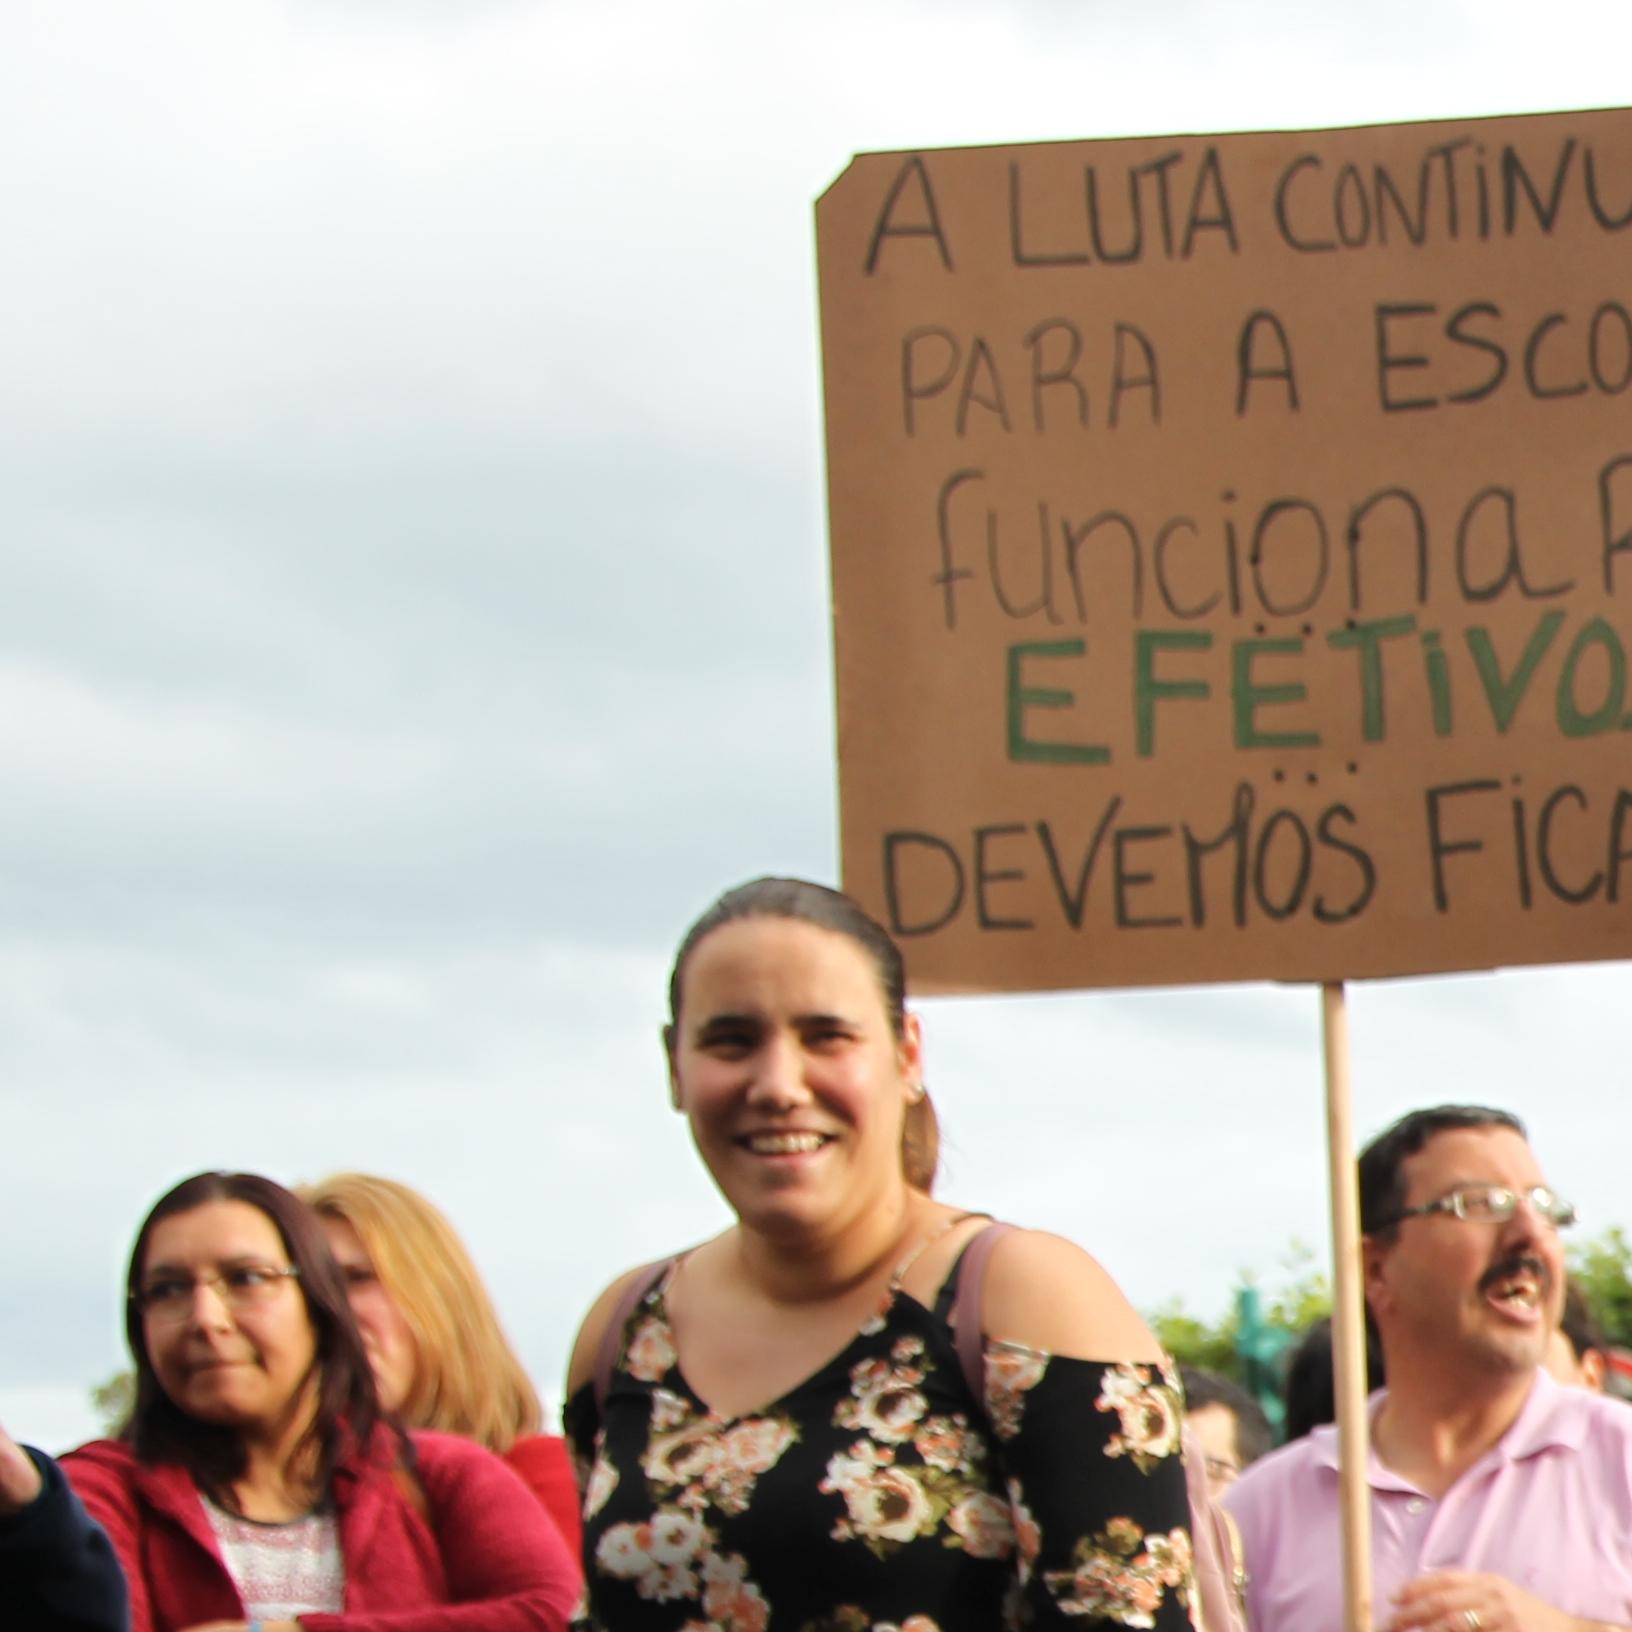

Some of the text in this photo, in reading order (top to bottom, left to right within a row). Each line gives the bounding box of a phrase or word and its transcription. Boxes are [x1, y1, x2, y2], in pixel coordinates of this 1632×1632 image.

[864, 155, 953, 275] A
[1010, 144, 1240, 267] LUTA
[902, 317, 1164, 437] PARA
[1236, 310, 1300, 416] A
[883, 781, 1378, 936] DEVEMOS
